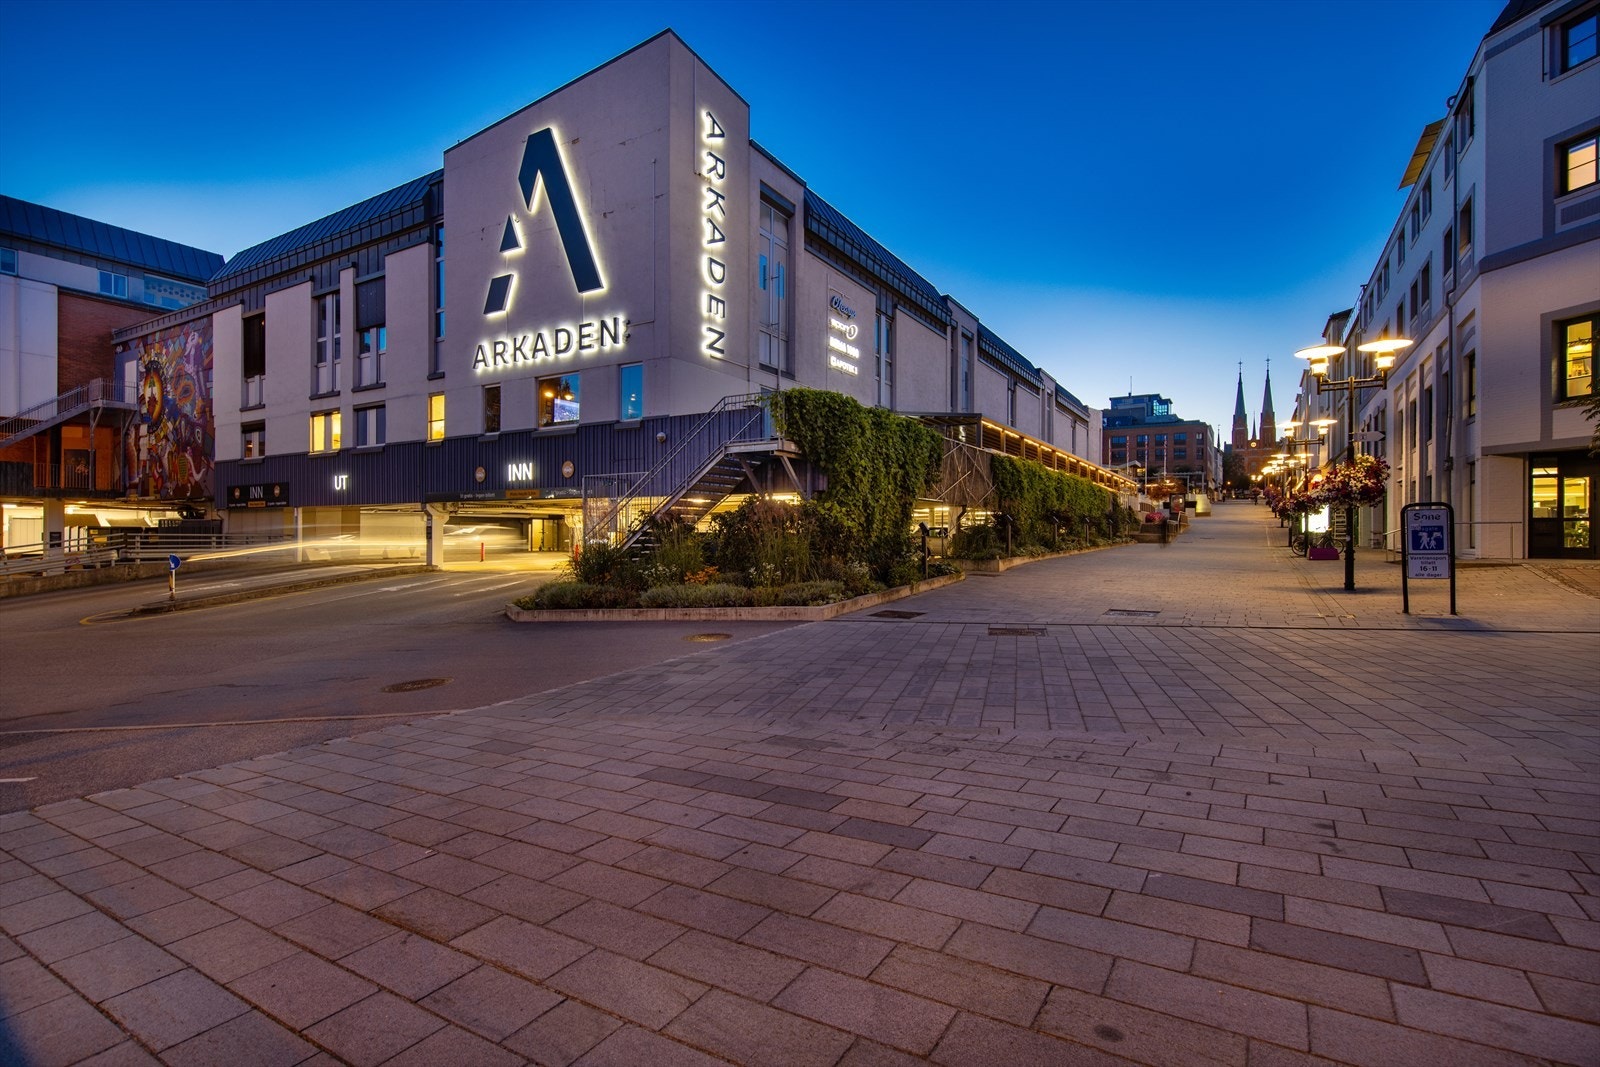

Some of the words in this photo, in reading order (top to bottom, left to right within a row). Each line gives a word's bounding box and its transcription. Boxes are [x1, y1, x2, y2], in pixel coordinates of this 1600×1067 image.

[706, 111, 726, 355] ARKADEN
[473, 317, 620, 369] ARKADEN
[508, 462, 533, 482] INN
[334, 475, 348, 490] UT
[250, 486, 264, 499] INN
[1413, 512, 1441, 521] Sone
